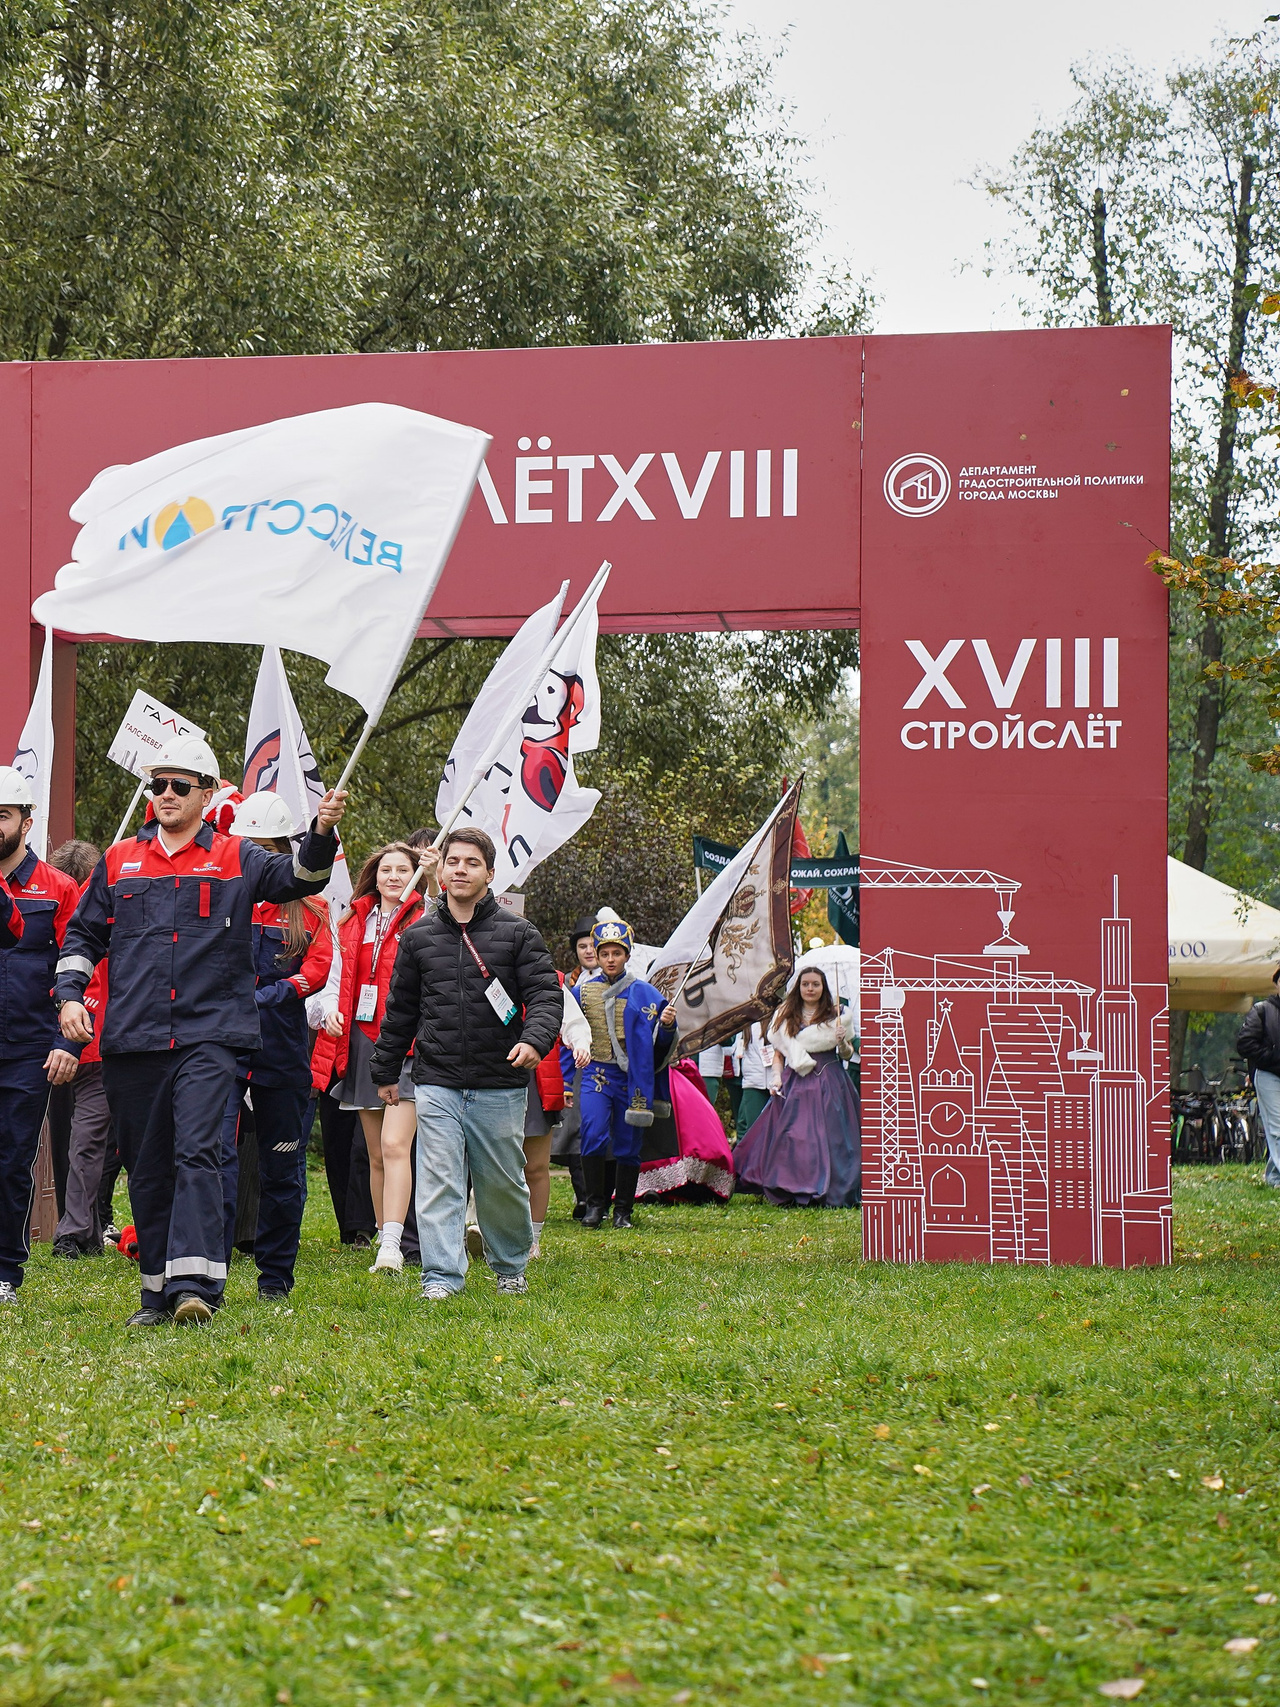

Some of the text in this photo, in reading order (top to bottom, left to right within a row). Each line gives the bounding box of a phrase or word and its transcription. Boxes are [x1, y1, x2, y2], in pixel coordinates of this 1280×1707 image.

[959, 465, 1037, 477] ДЕПАРТАМЕНТ
[959, 475, 1144, 489] ГРАДОСТРОИТЕЛЬНОЙ ПОЛИТИКИ
[959, 489, 1059, 501] ГОРОДА МОСКВЫ
[902, 638, 1119, 709] XVIII
[124, 722, 163, 751] ГАЛС-ДЕВЕЛ
[900, 713, 1122, 750] СТРОЙСЛЁТ
[704, 850, 731, 866] СОЗДА
[791, 866, 860, 878] ОЖАЙ. СОХРАН
